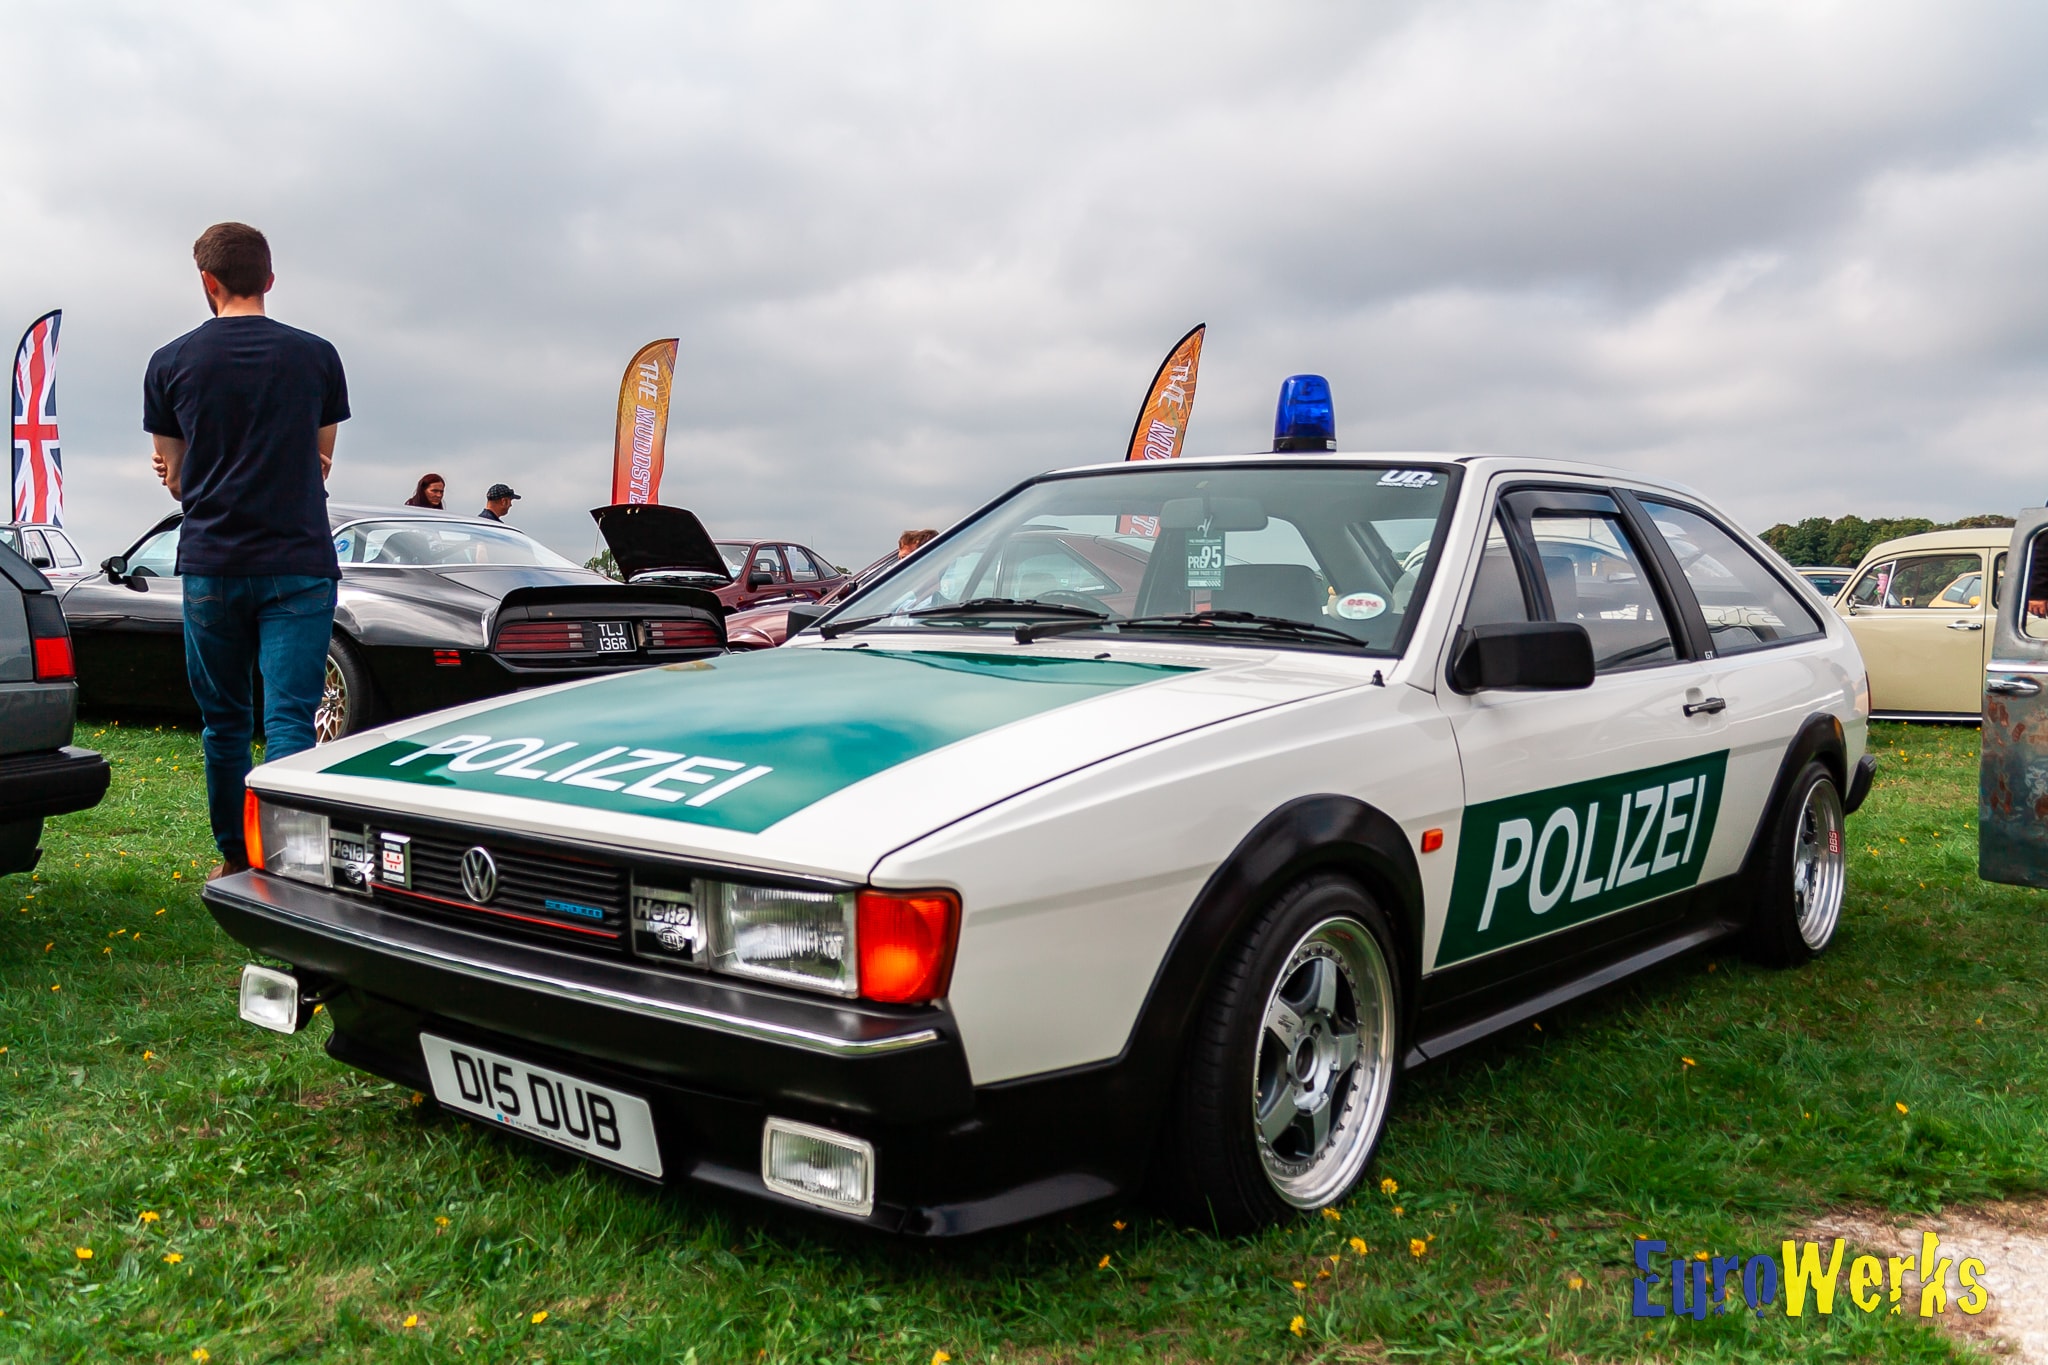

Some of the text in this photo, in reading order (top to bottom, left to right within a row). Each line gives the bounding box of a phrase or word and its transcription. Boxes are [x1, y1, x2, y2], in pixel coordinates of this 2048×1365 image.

[637, 359, 660, 403] THE
[1158, 358, 1192, 411] THE
[1201, 545, 1222, 569] 95
[597, 623, 624, 637] TLJ
[599, 637, 628, 651] 136R
[389, 734, 774, 808] POLIZEI
[332, 839, 364, 862] Hella
[1477, 774, 1707, 932] POLIZEI
[1828, 831, 1838, 853] BBS
[636, 898, 690, 926] Hella
[450, 1049, 622, 1151] D15 DUB
